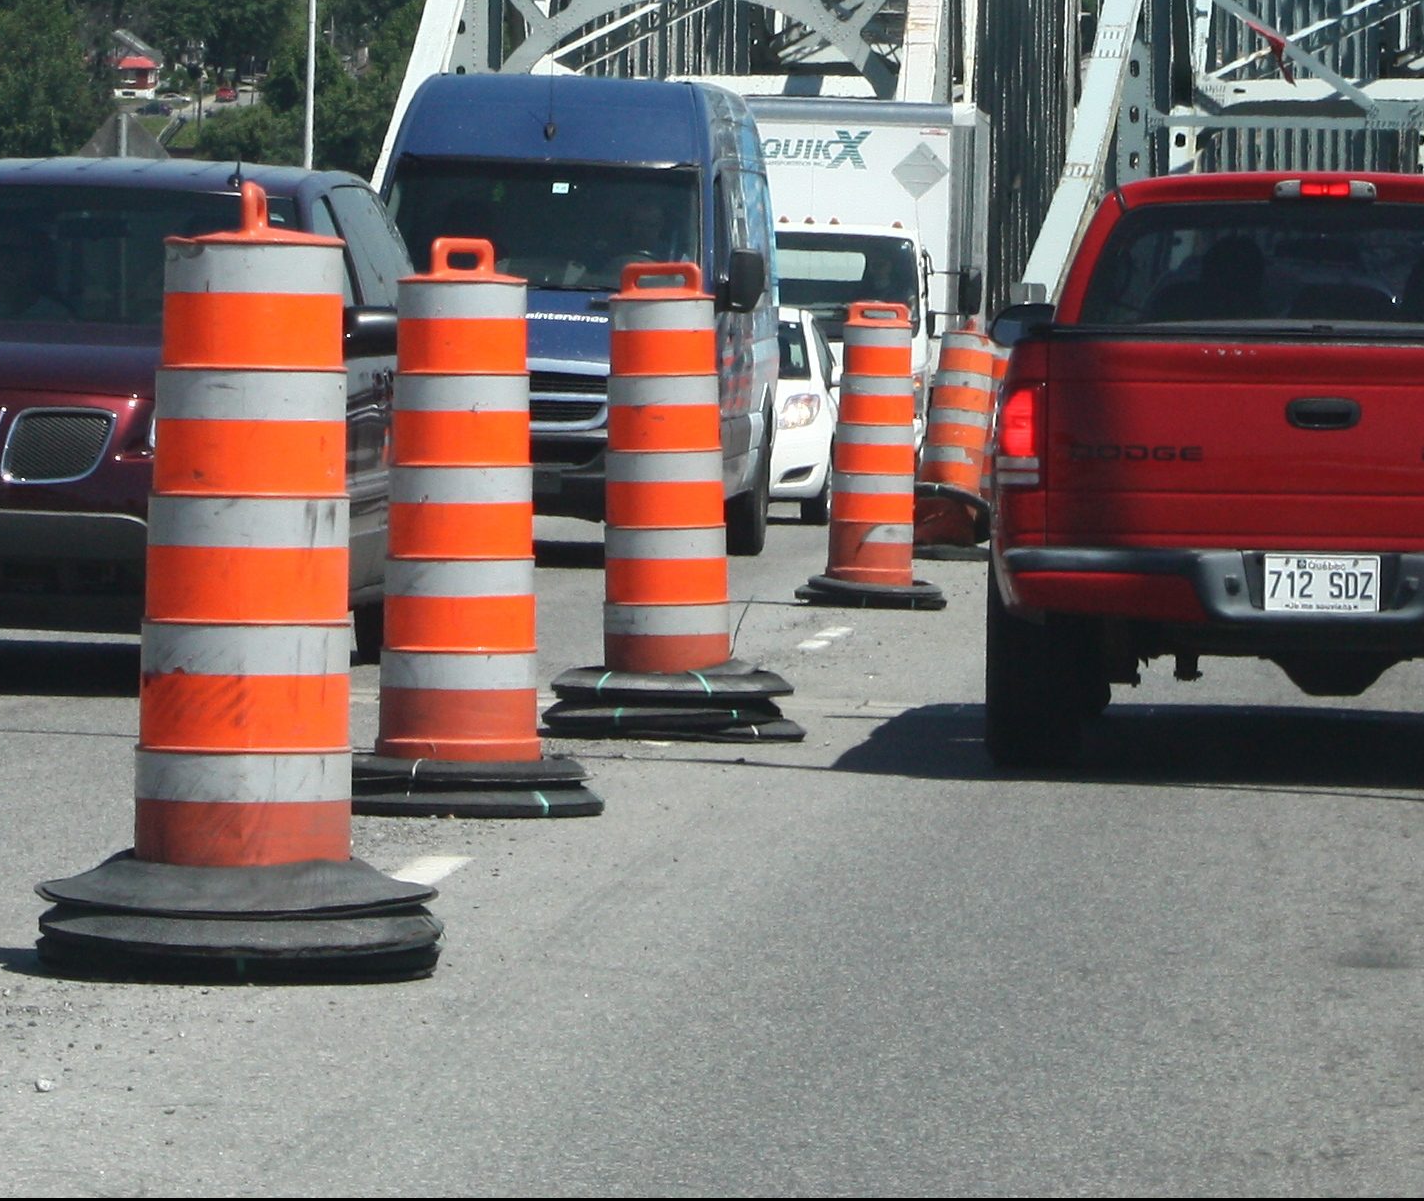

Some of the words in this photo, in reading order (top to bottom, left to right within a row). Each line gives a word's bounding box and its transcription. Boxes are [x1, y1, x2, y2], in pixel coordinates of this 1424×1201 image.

[525, 311, 609, 324] aintenance
[1070, 445, 1204, 462] DODGE
[1269, 571, 1313, 598] 712
[1329, 572, 1373, 599] SDZ
